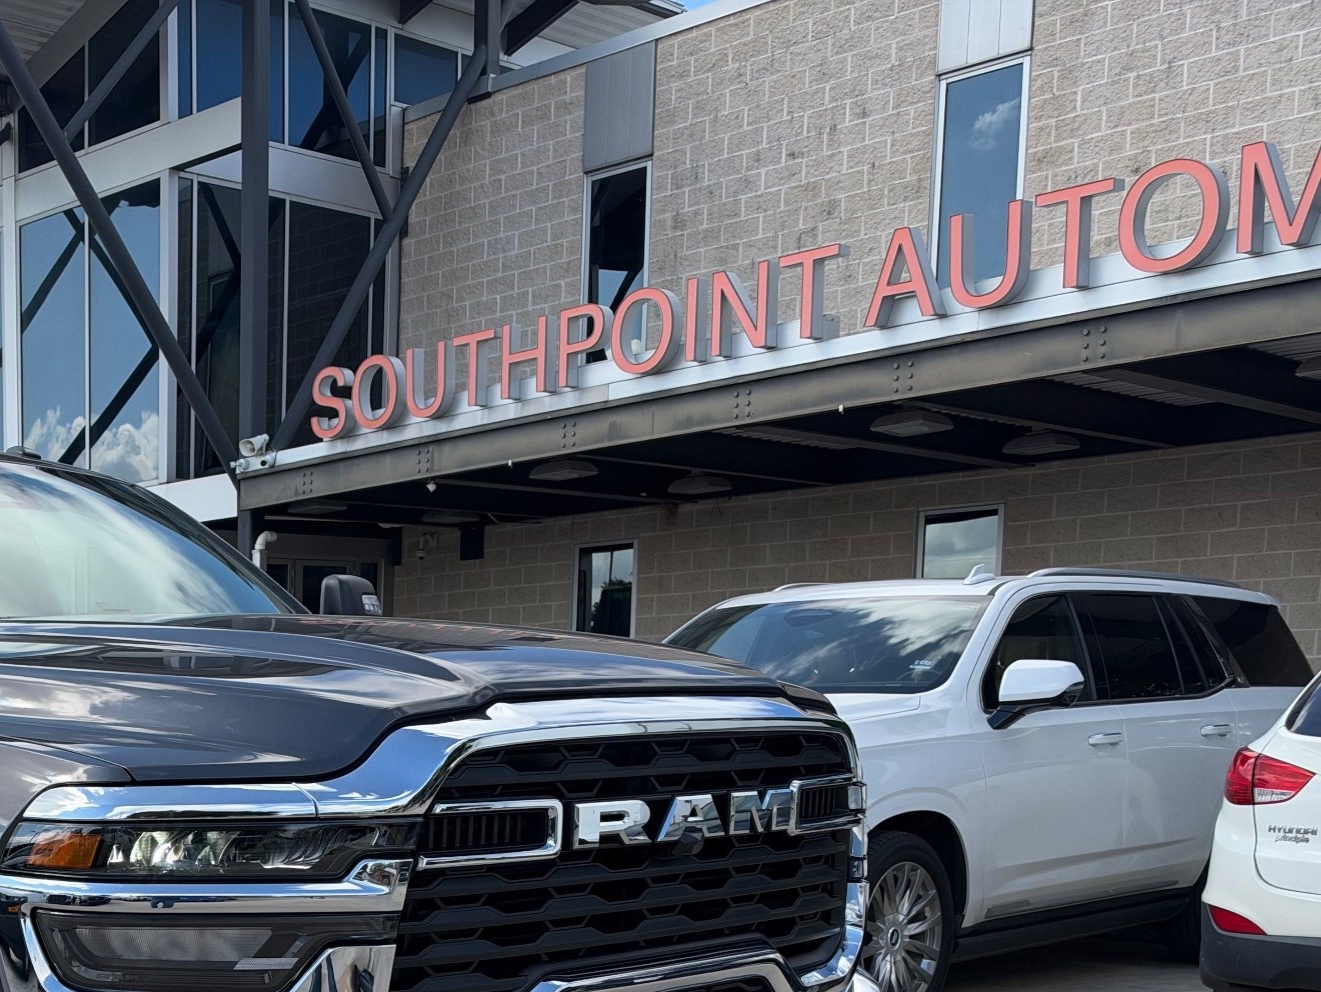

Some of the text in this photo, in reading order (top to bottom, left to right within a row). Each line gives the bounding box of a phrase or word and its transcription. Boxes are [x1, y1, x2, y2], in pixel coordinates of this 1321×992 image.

[312, 243, 849, 438] SOUTHPOINT
[572, 788, 795, 850] RAM
[1268, 825, 1318, 836] HYUNDAI
